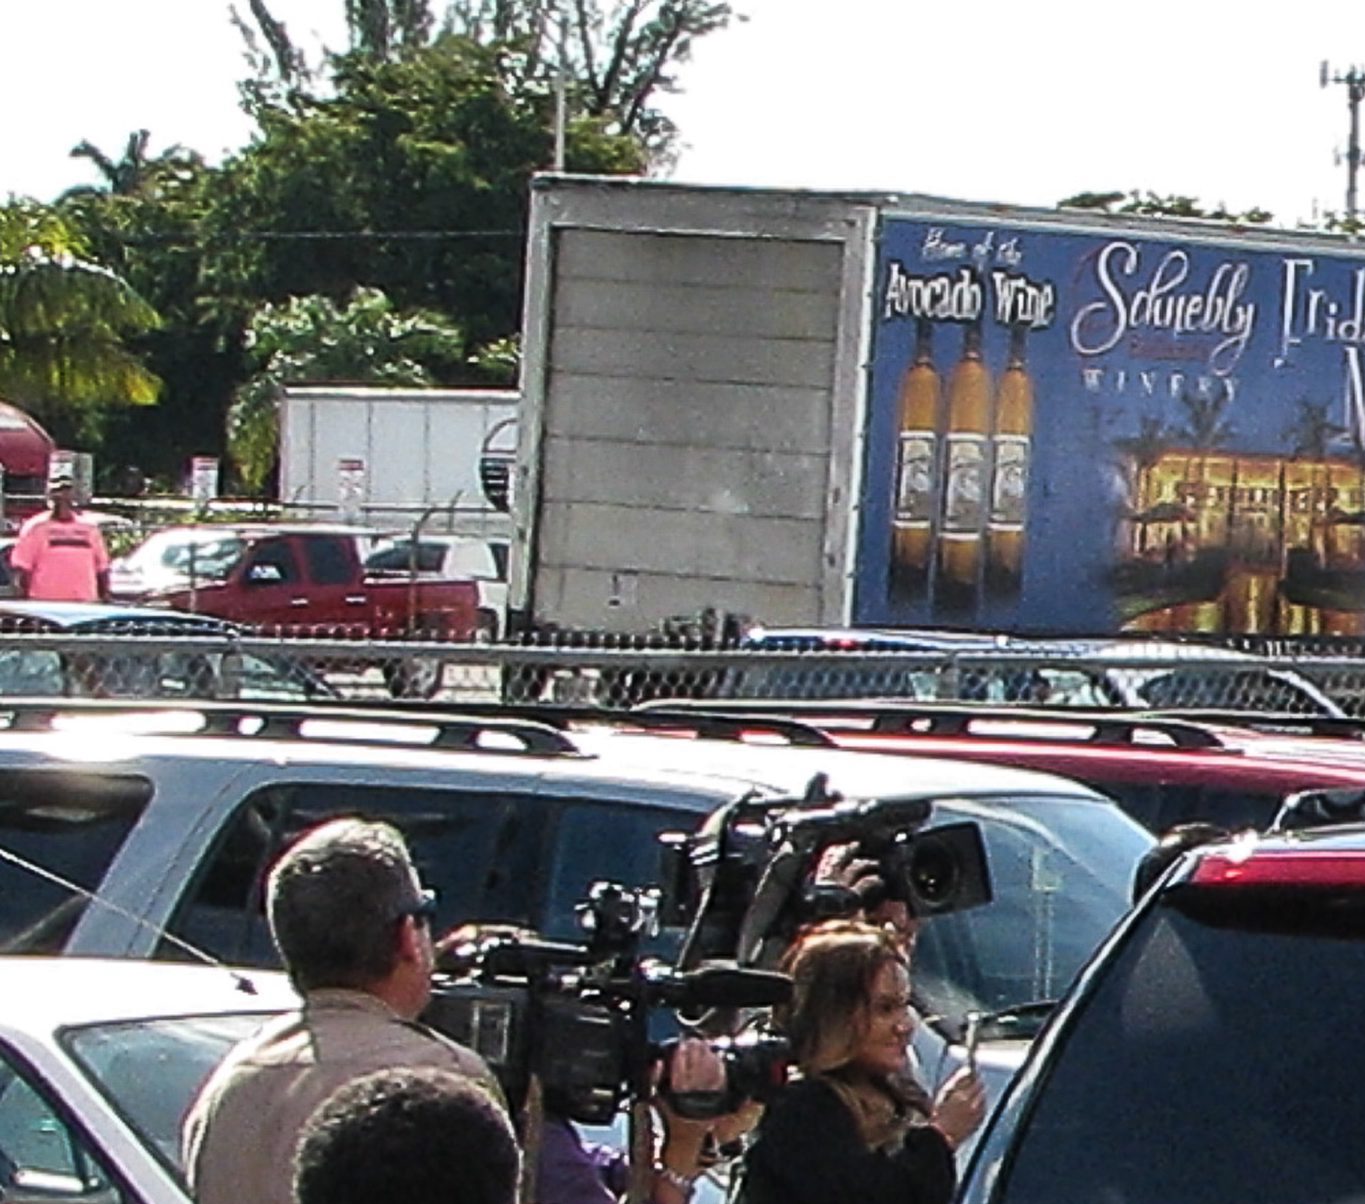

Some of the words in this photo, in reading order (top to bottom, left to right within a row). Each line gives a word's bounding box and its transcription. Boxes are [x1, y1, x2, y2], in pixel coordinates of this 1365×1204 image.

[885, 263, 982, 319] Avocado
[992, 270, 1054, 327] Wine
[1070, 241, 1255, 377] Schnebly
